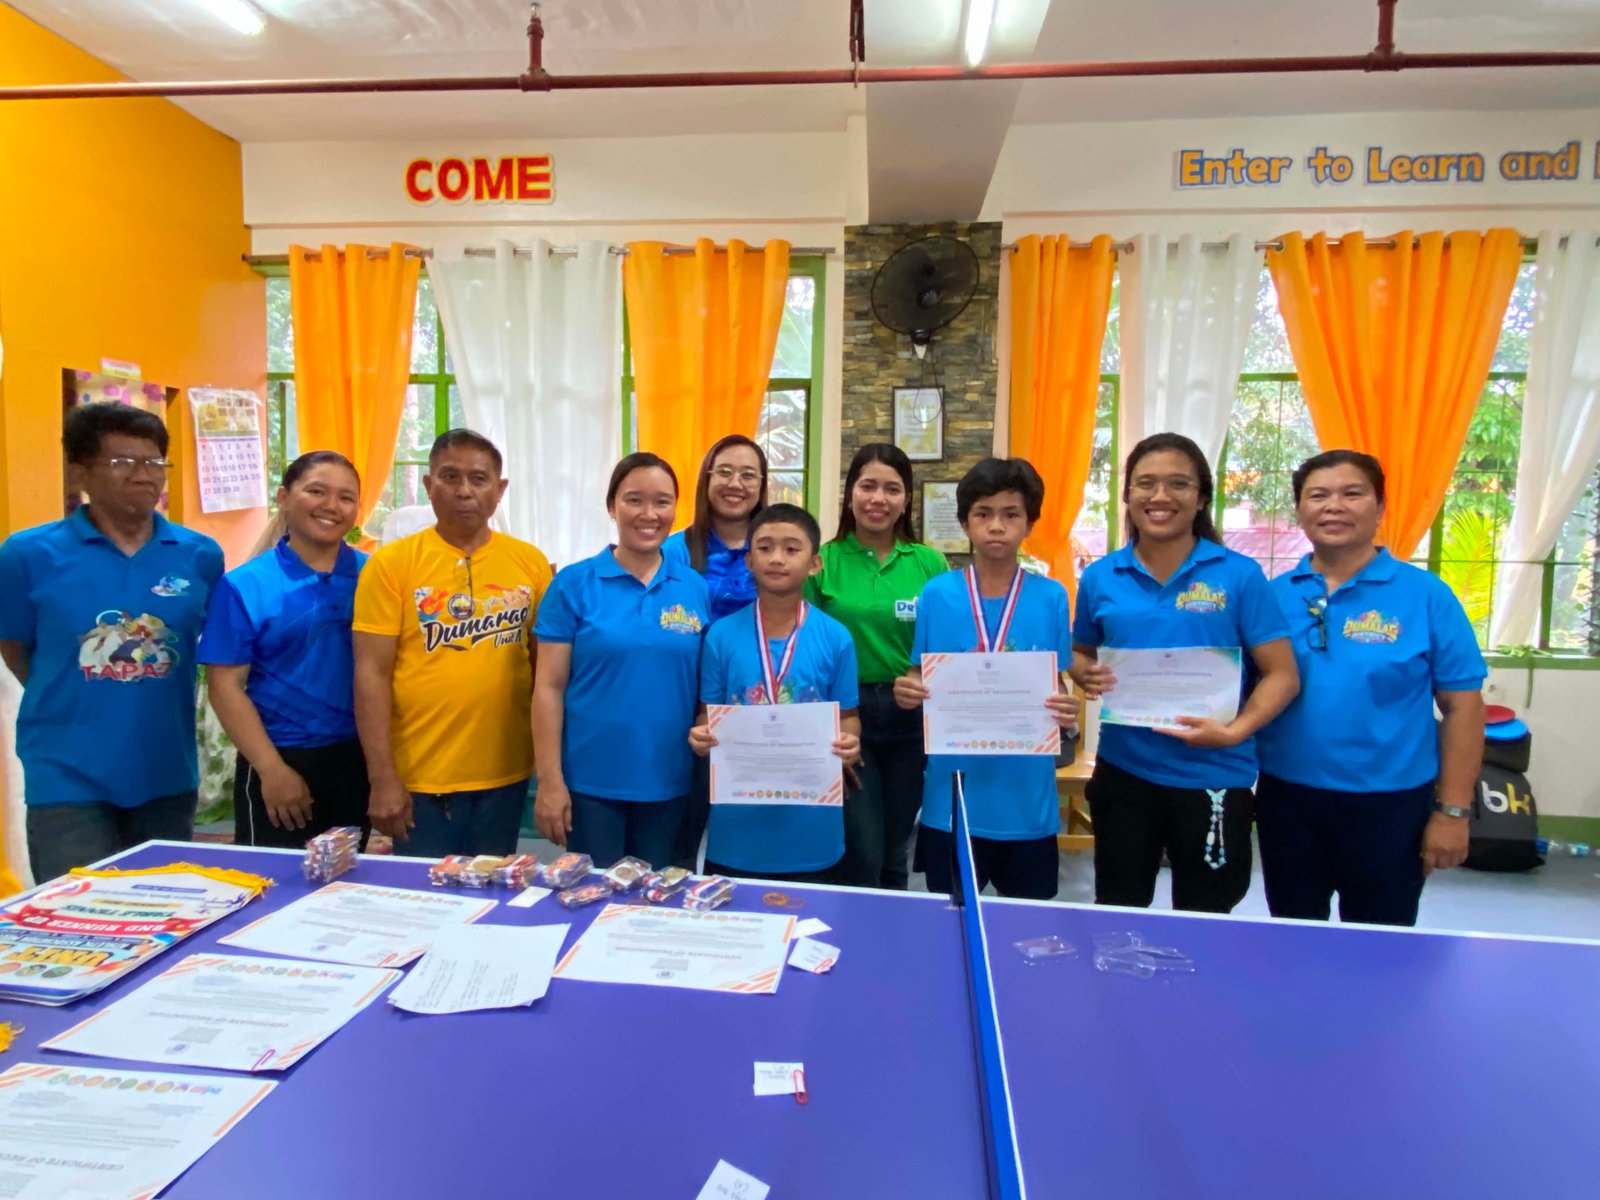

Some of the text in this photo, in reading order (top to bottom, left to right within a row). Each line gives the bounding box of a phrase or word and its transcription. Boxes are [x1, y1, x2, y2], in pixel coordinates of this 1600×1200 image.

[405, 156, 551, 202] COME
[1179, 148, 1293, 186] Enter
[1308, 146, 1353, 184] to
[1366, 146, 1485, 184] Learn
[1500, 140, 1581, 180] and
[423, 606, 529, 652] Dumarao
[1481, 780, 1530, 815] bk
[24, 915, 49, 924] UP
[48, 919, 122, 931] RUNNER
[4, 946, 113, 967] UNIT
